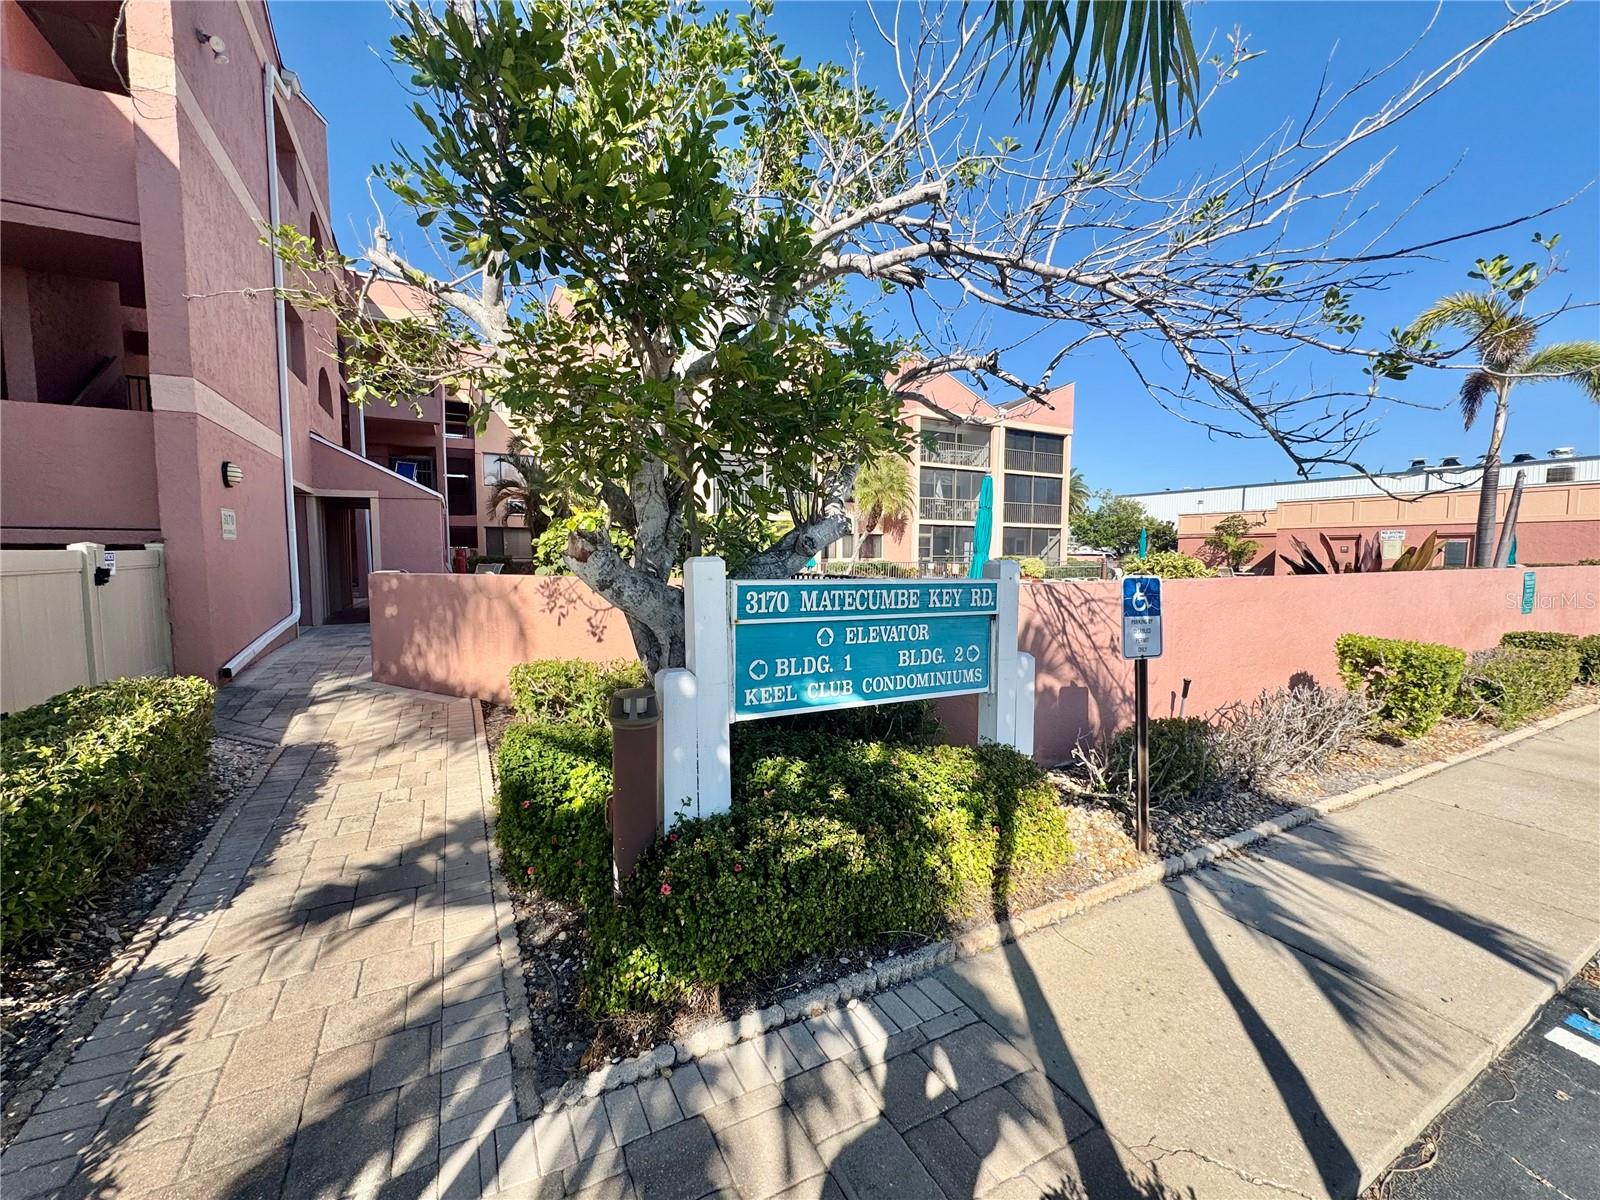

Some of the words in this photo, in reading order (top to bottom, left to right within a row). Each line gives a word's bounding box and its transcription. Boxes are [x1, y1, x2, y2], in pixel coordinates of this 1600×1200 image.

[745, 590, 789, 613] 3170
[800, 589, 920, 612] MATECUMBE
[928, 588, 963, 608] KEY
[970, 587, 995, 607] RD.
[845, 624, 929, 645] ELEVATOR
[775, 655, 834, 677] BLDG.
[844, 654, 853, 671] 1
[898, 648, 946, 667] BLDG.
[954, 646, 964, 662] 2
[744, 685, 797, 706] KEEL
[807, 679, 853, 699] CLUB
[862, 668, 983, 694] CONDOMINIUMS
